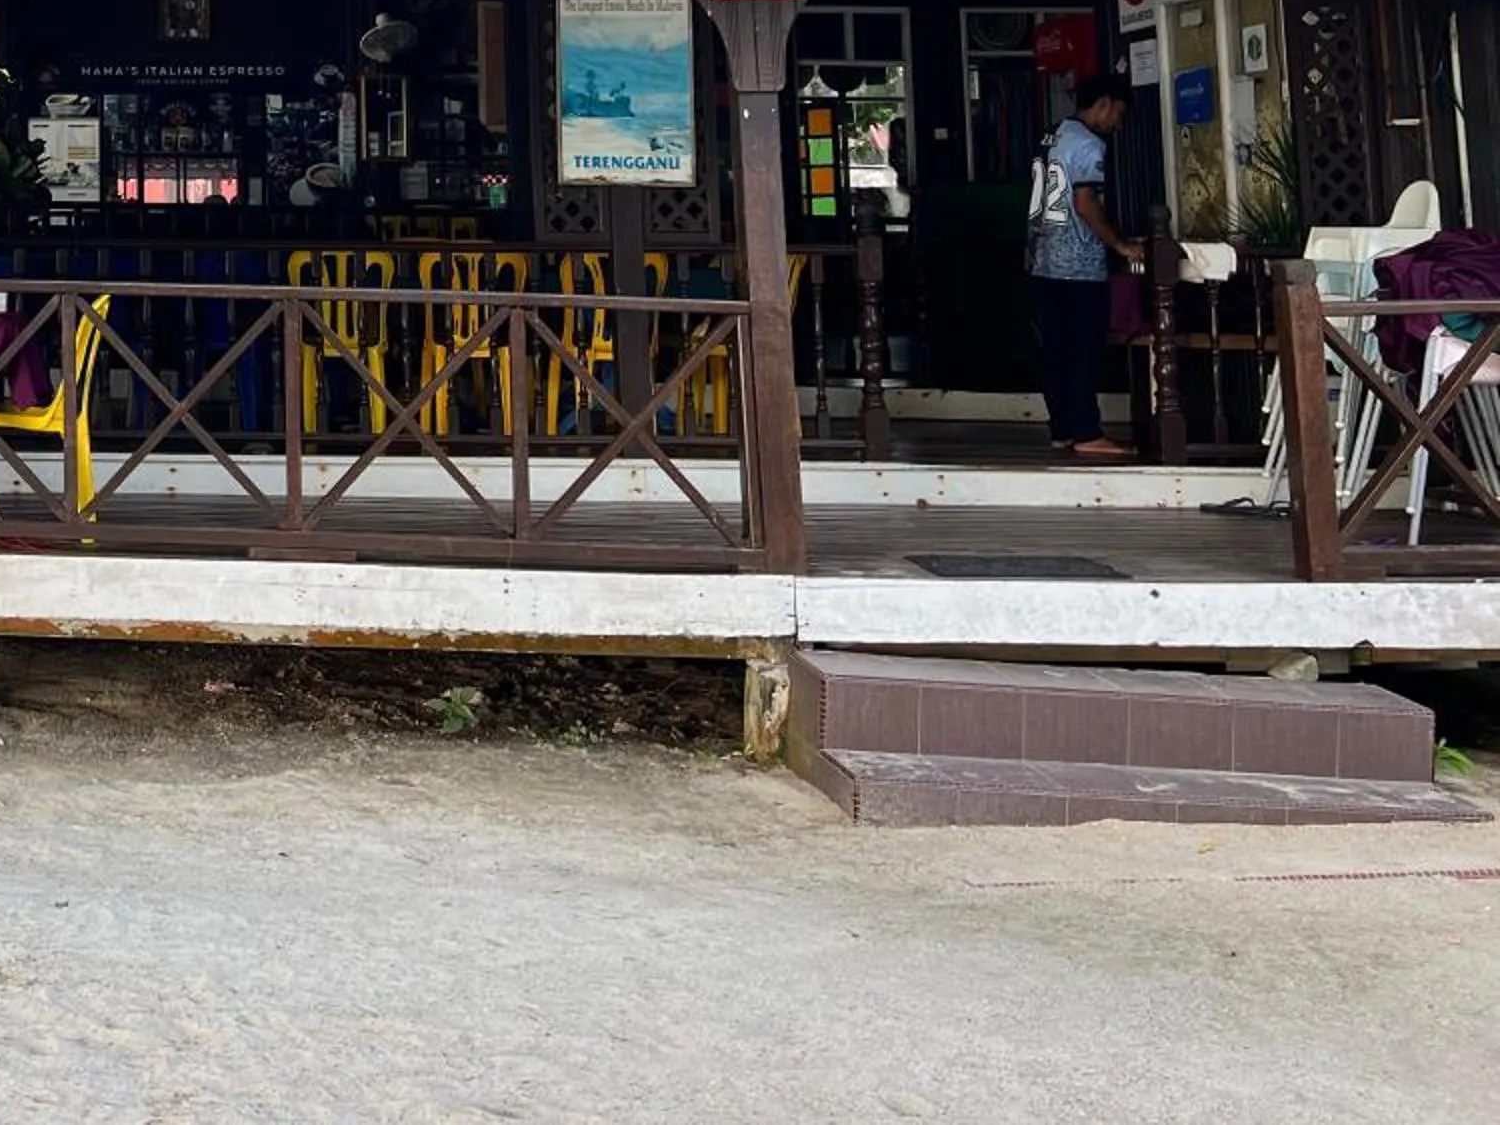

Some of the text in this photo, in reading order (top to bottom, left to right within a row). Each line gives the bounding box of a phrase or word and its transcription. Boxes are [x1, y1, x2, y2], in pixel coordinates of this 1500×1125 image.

[81, 66, 284, 76] MAMA'S ITALIAN ESPRESSO
[574, 155, 680, 170] TERENGGANU
